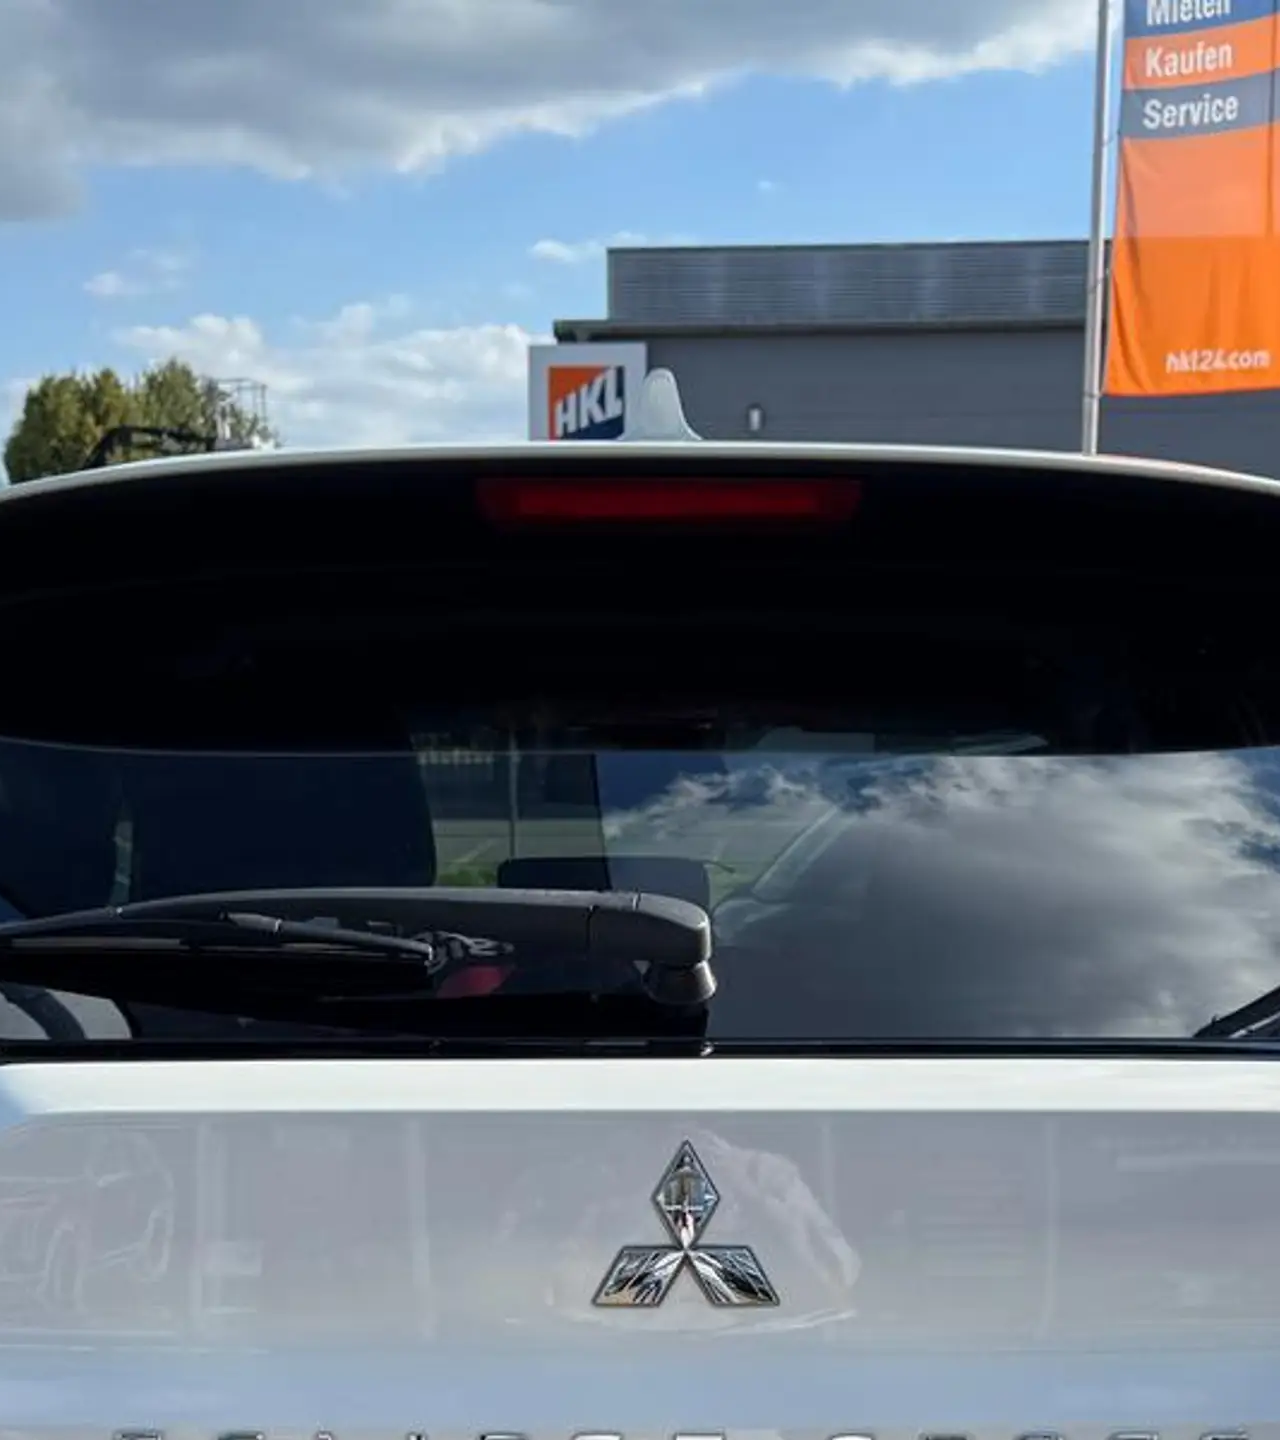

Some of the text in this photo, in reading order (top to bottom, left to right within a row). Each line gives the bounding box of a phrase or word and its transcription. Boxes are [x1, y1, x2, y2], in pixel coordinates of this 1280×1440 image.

[1146, 0, 1231, 26] Mieten
[1145, 41, 1233, 78] Kaufen
[1142, 93, 1239, 130] Service
[555, 365, 623, 437] HKL
